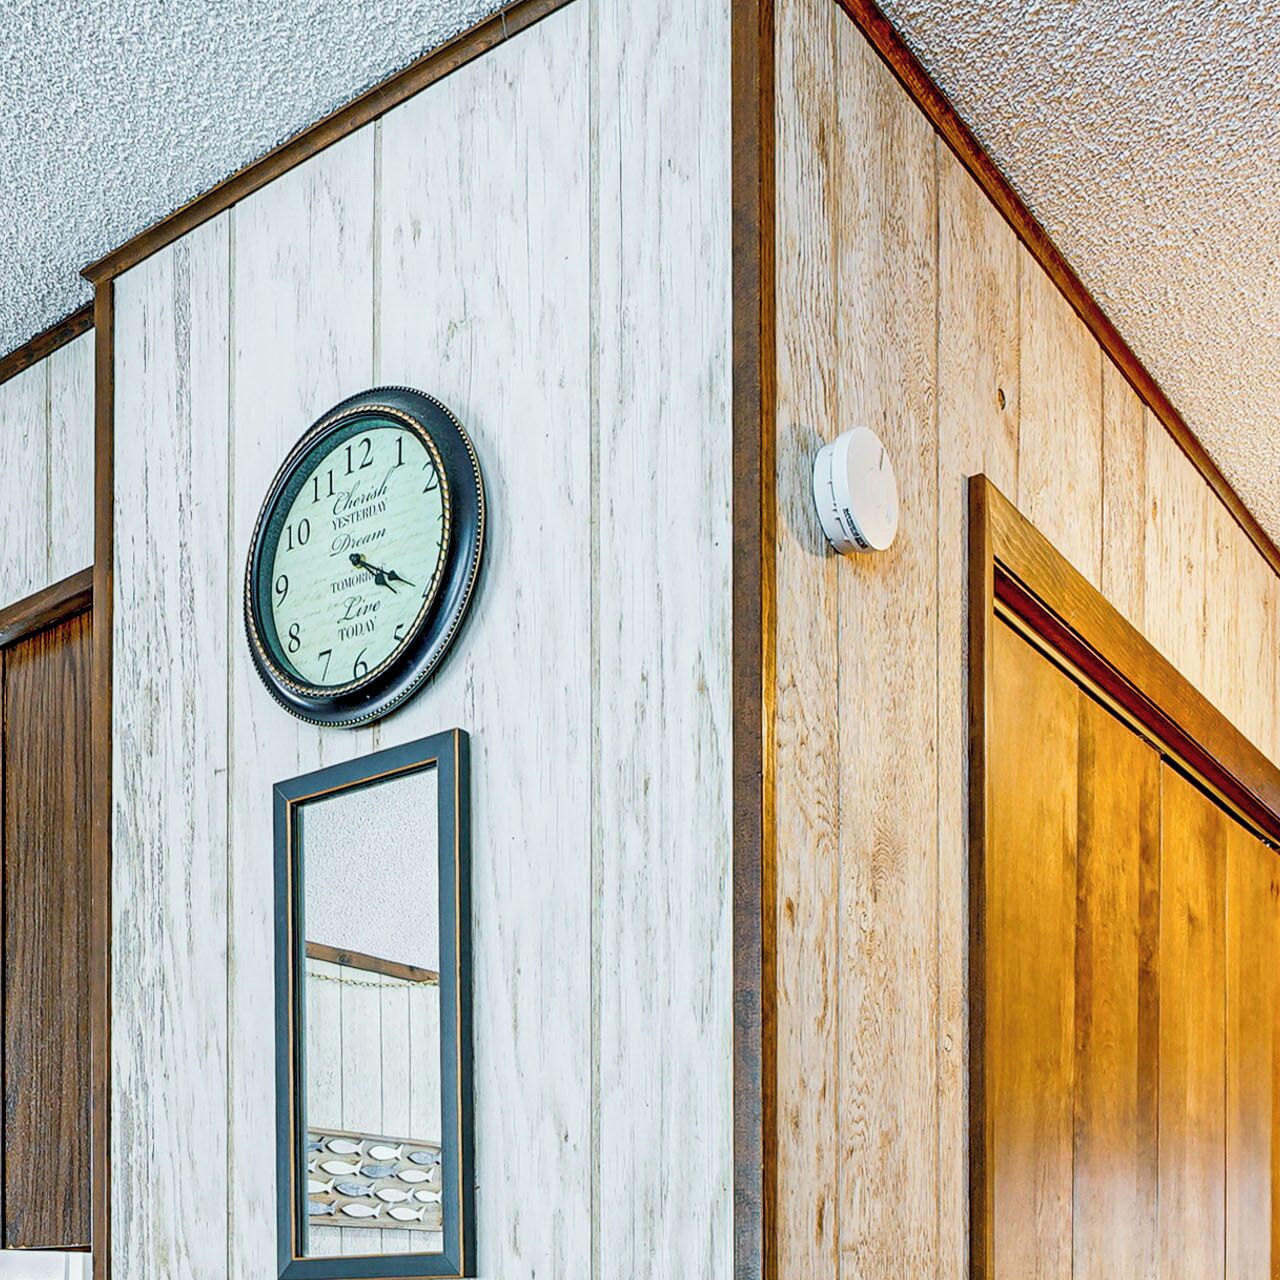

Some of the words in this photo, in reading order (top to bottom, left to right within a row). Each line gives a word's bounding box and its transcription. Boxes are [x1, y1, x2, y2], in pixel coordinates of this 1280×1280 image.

[344, 437, 374, 476] 12
[395, 436, 405, 469] 1
[312, 469, 335, 504] 11
[333, 465, 395, 516] Cherish
[422, 461, 439, 494] 2
[332, 498, 388, 530] YESTERDAY
[286, 518, 310, 552] 10
[329, 528, 386, 557] Dream
[275, 574, 289, 608] 9
[337, 596, 380, 624] Live
[288, 622, 301, 653] 8
[338, 616, 377, 642] TODAY
[318, 648, 332, 682] 7
[353, 647, 368, 679] 6
